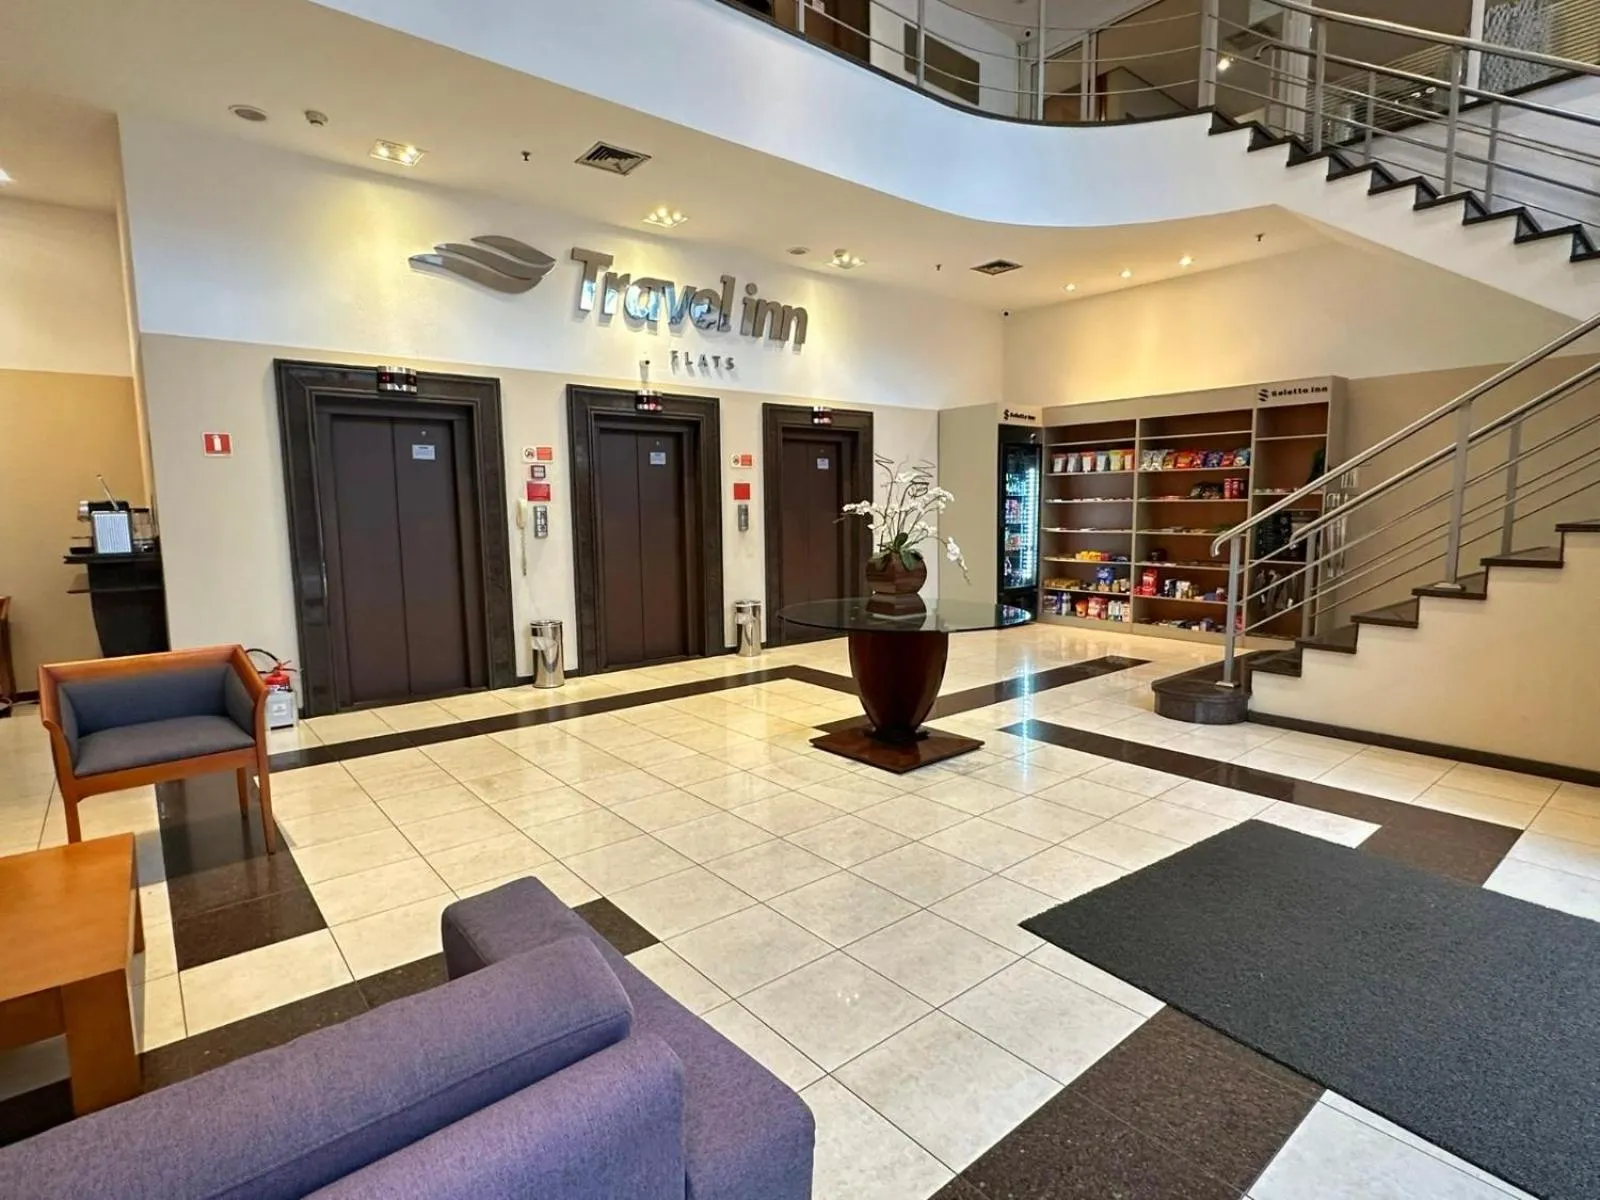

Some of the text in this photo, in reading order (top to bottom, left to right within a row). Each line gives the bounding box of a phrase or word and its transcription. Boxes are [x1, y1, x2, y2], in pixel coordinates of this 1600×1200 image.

[571, 247, 808, 345] Travel inn
[670, 350, 735, 371] FLATS
